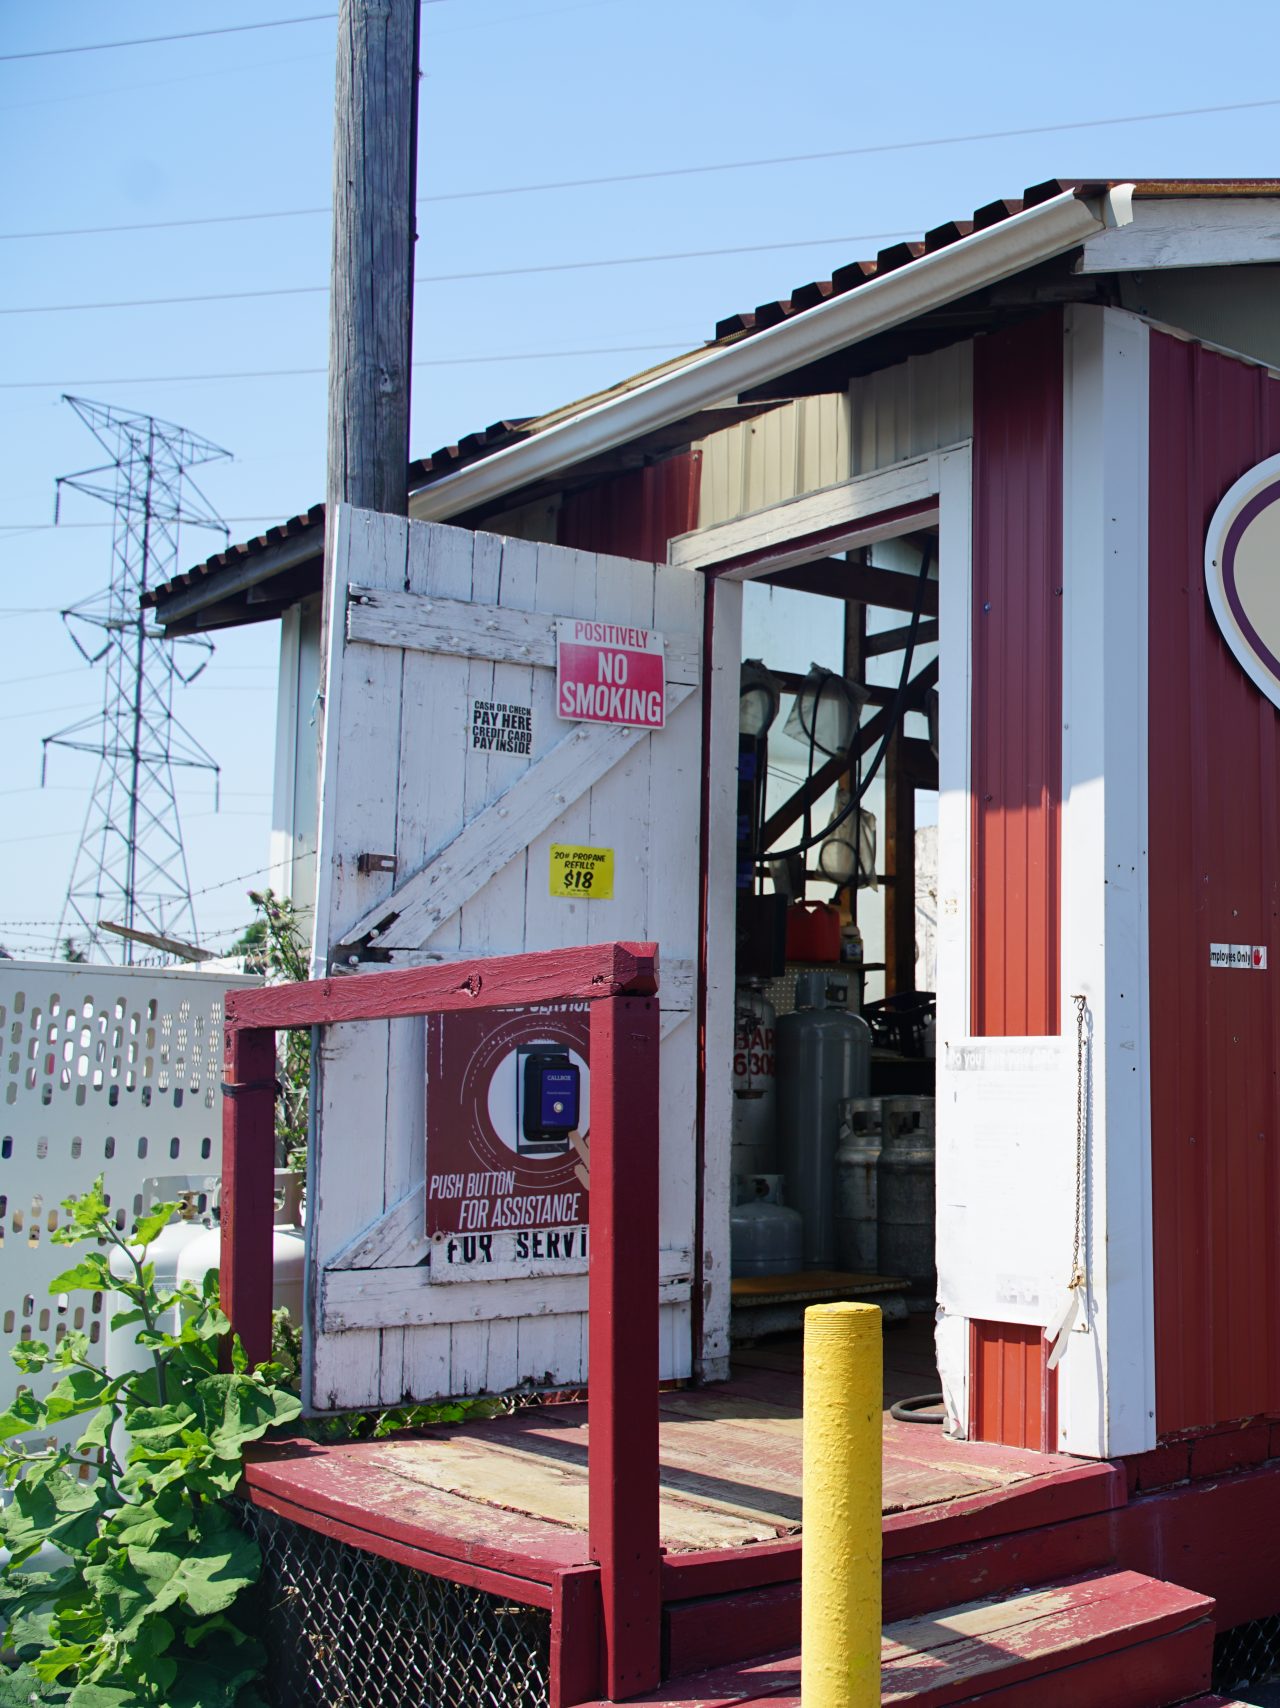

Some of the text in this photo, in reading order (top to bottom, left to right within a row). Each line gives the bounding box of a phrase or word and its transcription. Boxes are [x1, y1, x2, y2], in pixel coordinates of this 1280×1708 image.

[575, 621, 648, 649] POSITIVELY
[598, 651, 628, 685] NO
[474, 700, 495, 712] CASH
[496, 703, 508, 712] OR
[561, 680, 661, 723] SMOKING
[473, 709, 532, 732] PAY HERE
[472, 725, 532, 743] CREDIT CARD
[473, 736, 531, 755] PAY INSIDE
[564, 860, 596, 870] REFILLS
[572, 852, 607, 863] PROPANE
[563, 868, 594, 889] $18
[429, 1170, 516, 1200] PUSH BUTTON
[458, 1192, 582, 1230] FOR ASSISTANCE
